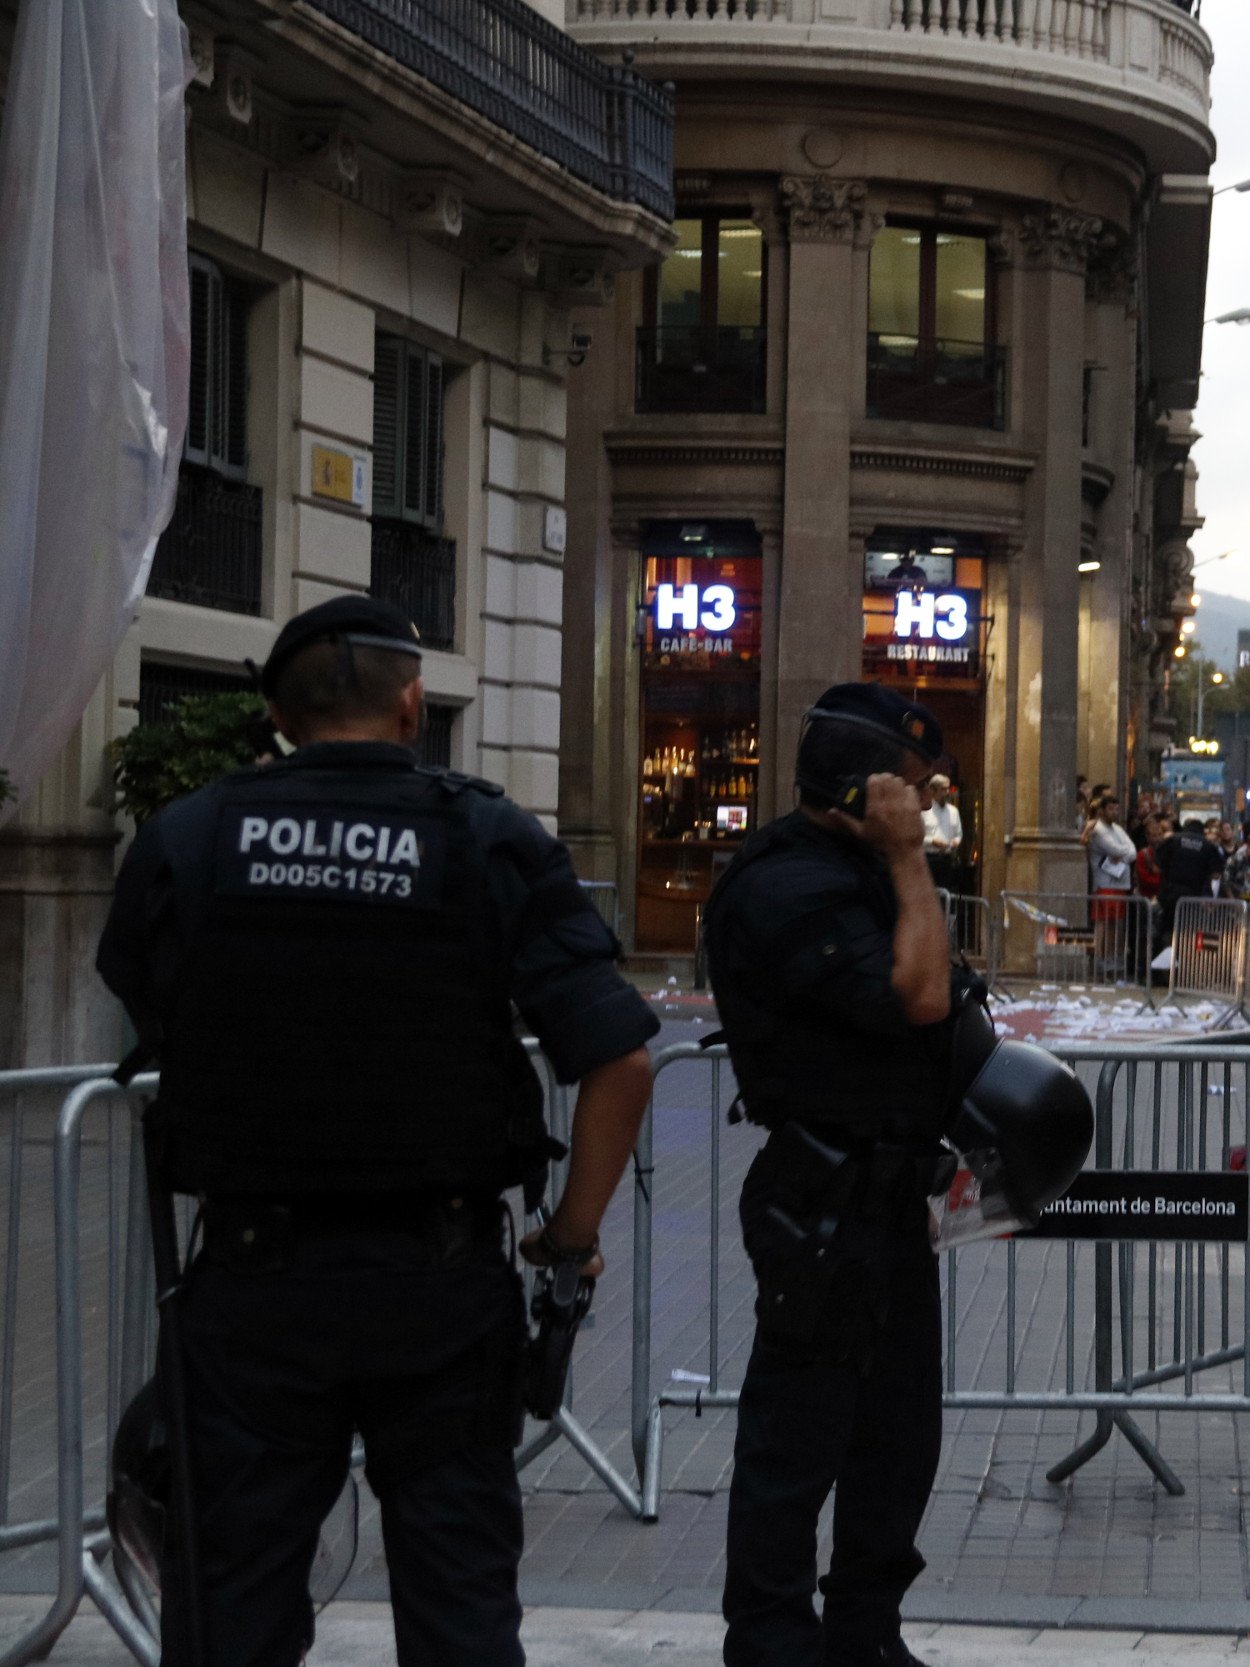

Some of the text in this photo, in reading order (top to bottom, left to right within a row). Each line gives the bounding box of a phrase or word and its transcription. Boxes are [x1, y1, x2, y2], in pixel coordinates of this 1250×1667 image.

[657, 583, 736, 631] H3
[896, 591, 968, 640] H3
[887, 644, 969, 662] RESTAURANT
[240, 817, 421, 868] POLICIA
[249, 862, 412, 898] D005C1573
[1040, 1196, 1236, 1216] untament de Barcelona
